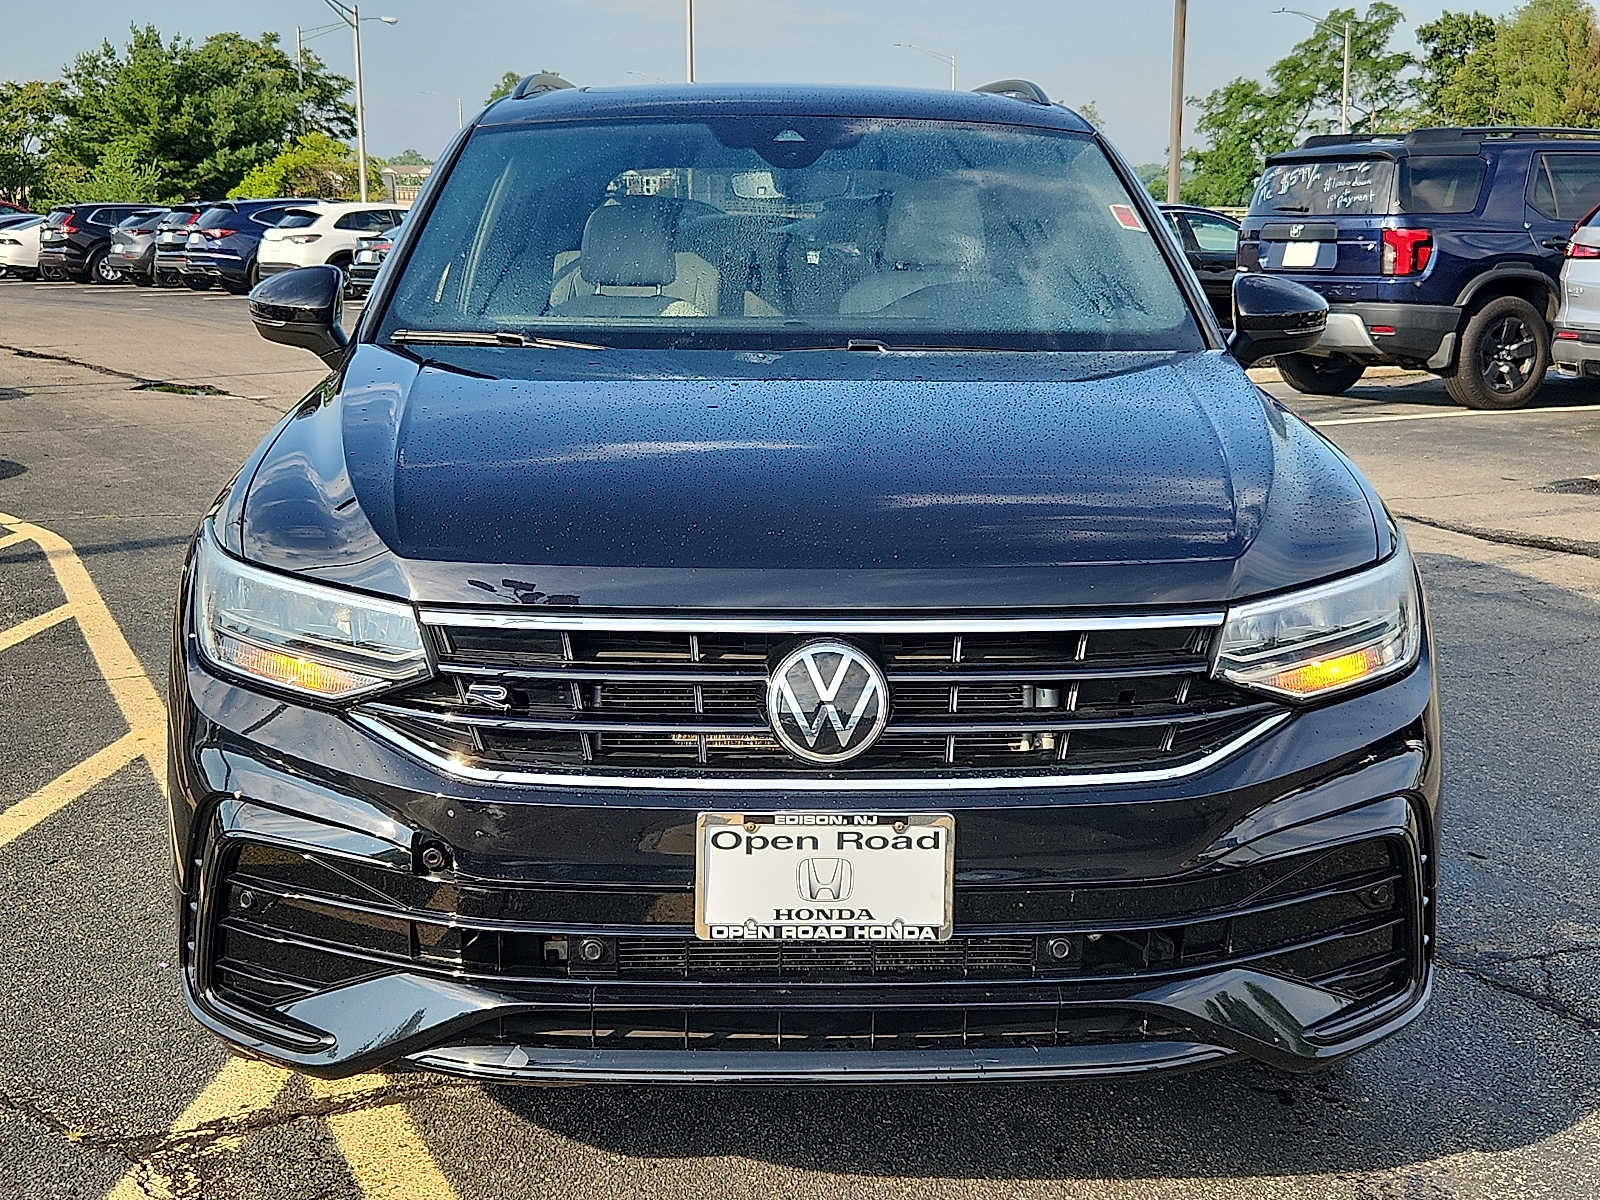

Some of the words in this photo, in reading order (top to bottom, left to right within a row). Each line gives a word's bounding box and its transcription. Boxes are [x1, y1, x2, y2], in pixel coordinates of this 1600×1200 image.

[854, 816, 878, 825] NJ
[711, 830, 819, 855] Open
[837, 830, 940, 850] Road
[773, 908, 876, 920] HONDA
[711, 925, 775, 939] OPEN
[782, 925, 847, 939] ROAD
[853, 925, 936, 939] HONDA
